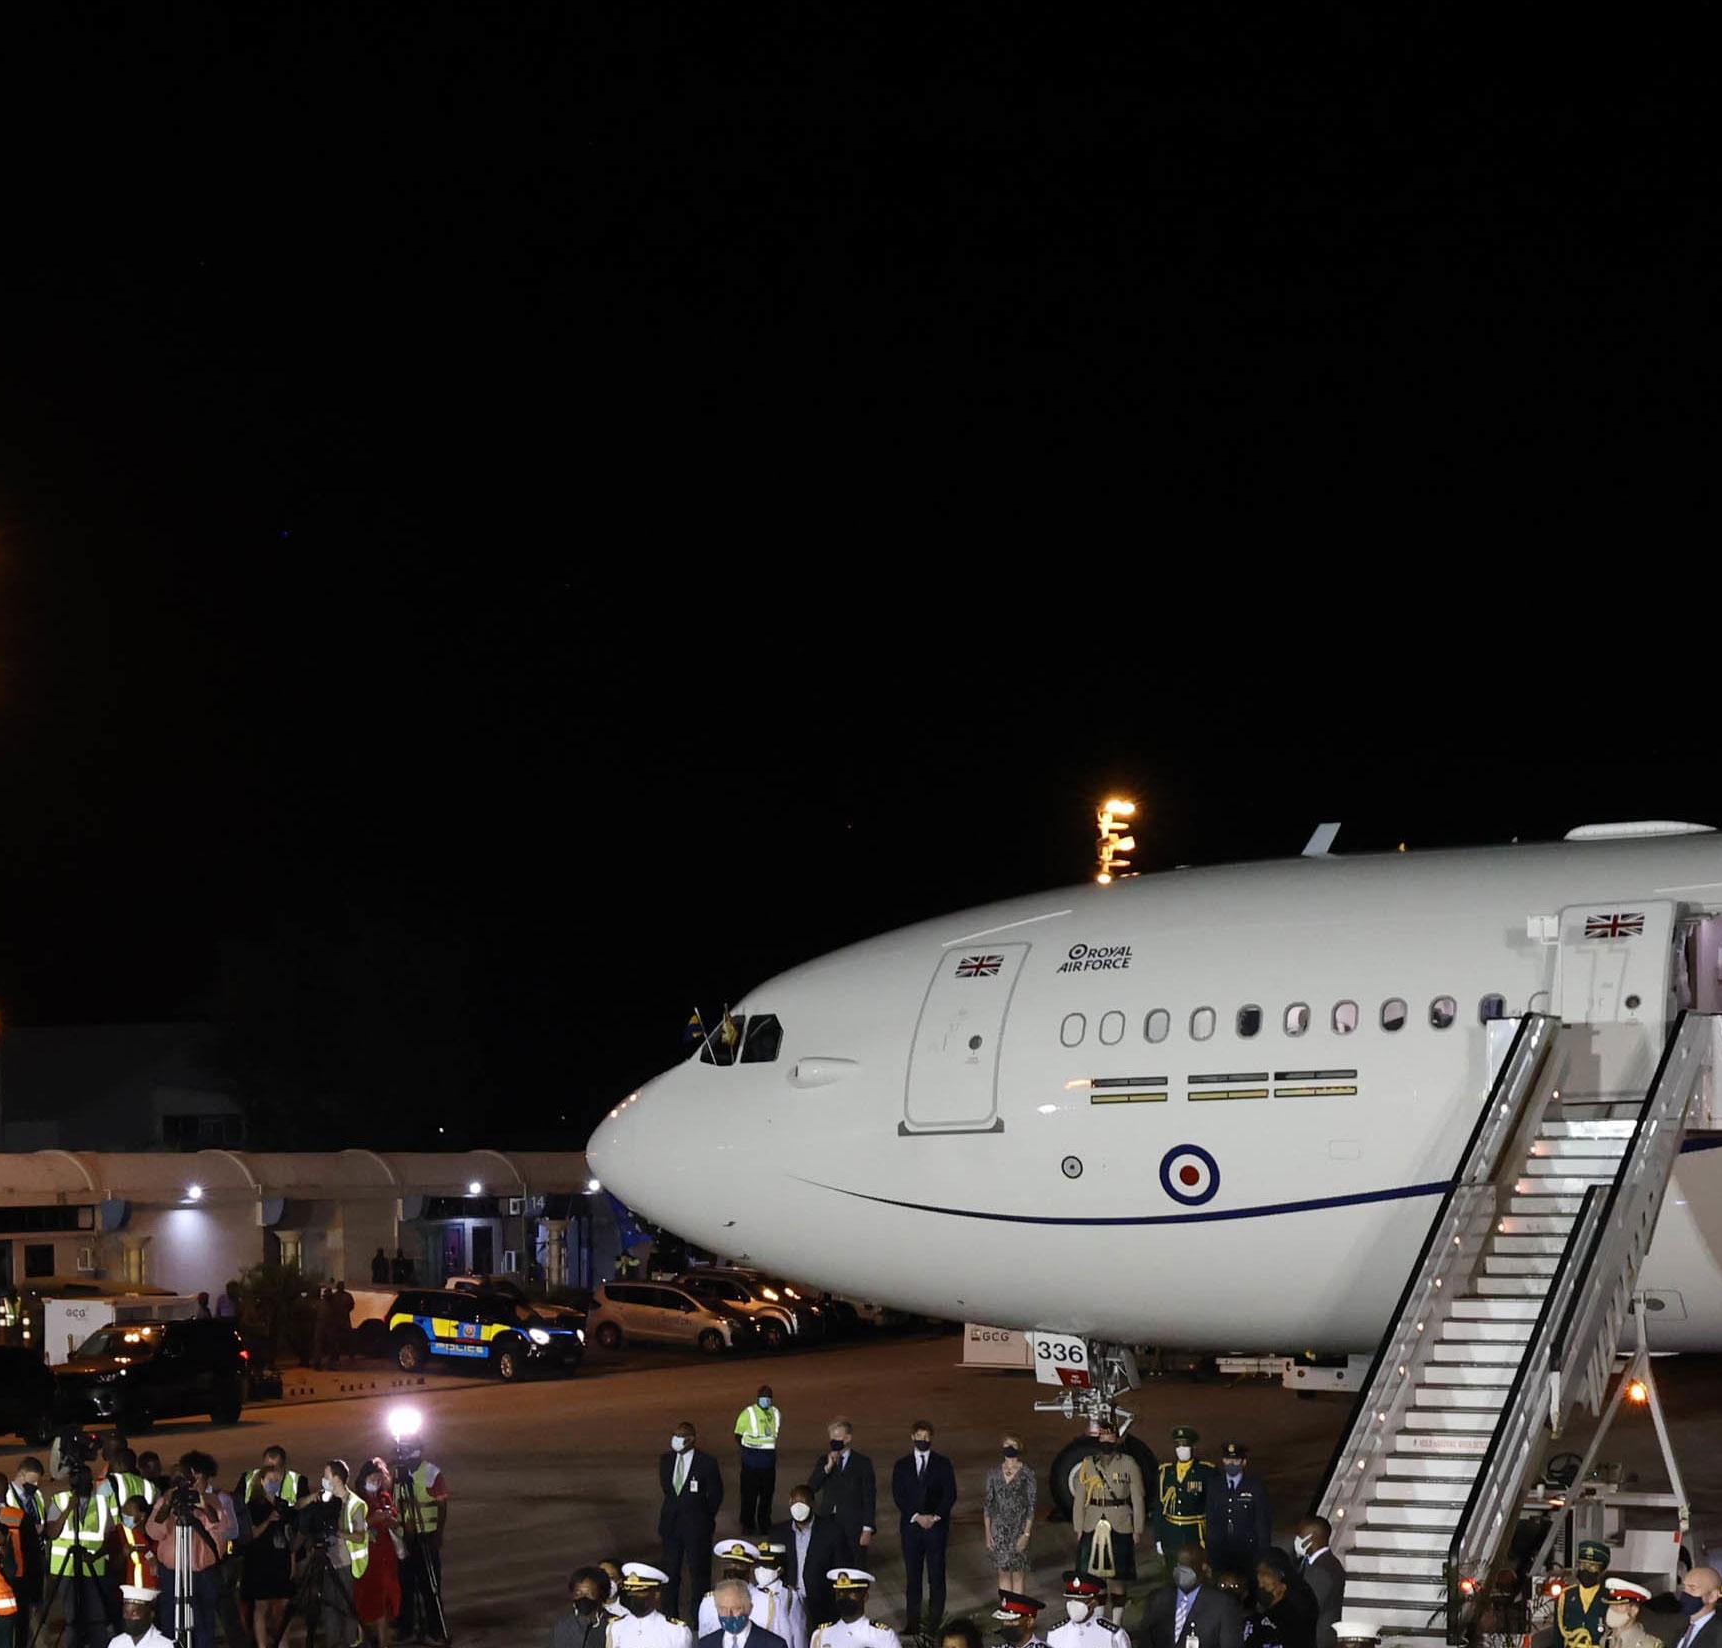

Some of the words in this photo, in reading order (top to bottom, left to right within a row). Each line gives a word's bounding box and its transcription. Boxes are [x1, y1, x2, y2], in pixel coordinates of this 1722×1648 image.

[1088, 946, 1133, 959] ROYAL
[1056, 961, 1083, 974] AIR
[1084, 957, 1132, 971] FORCE
[531, 1196, 545, 1209] 14
[66, 1308, 86, 1318] GCG
[982, 1331, 1010, 1342] GCG
[1037, 1341, 1084, 1363] 336
